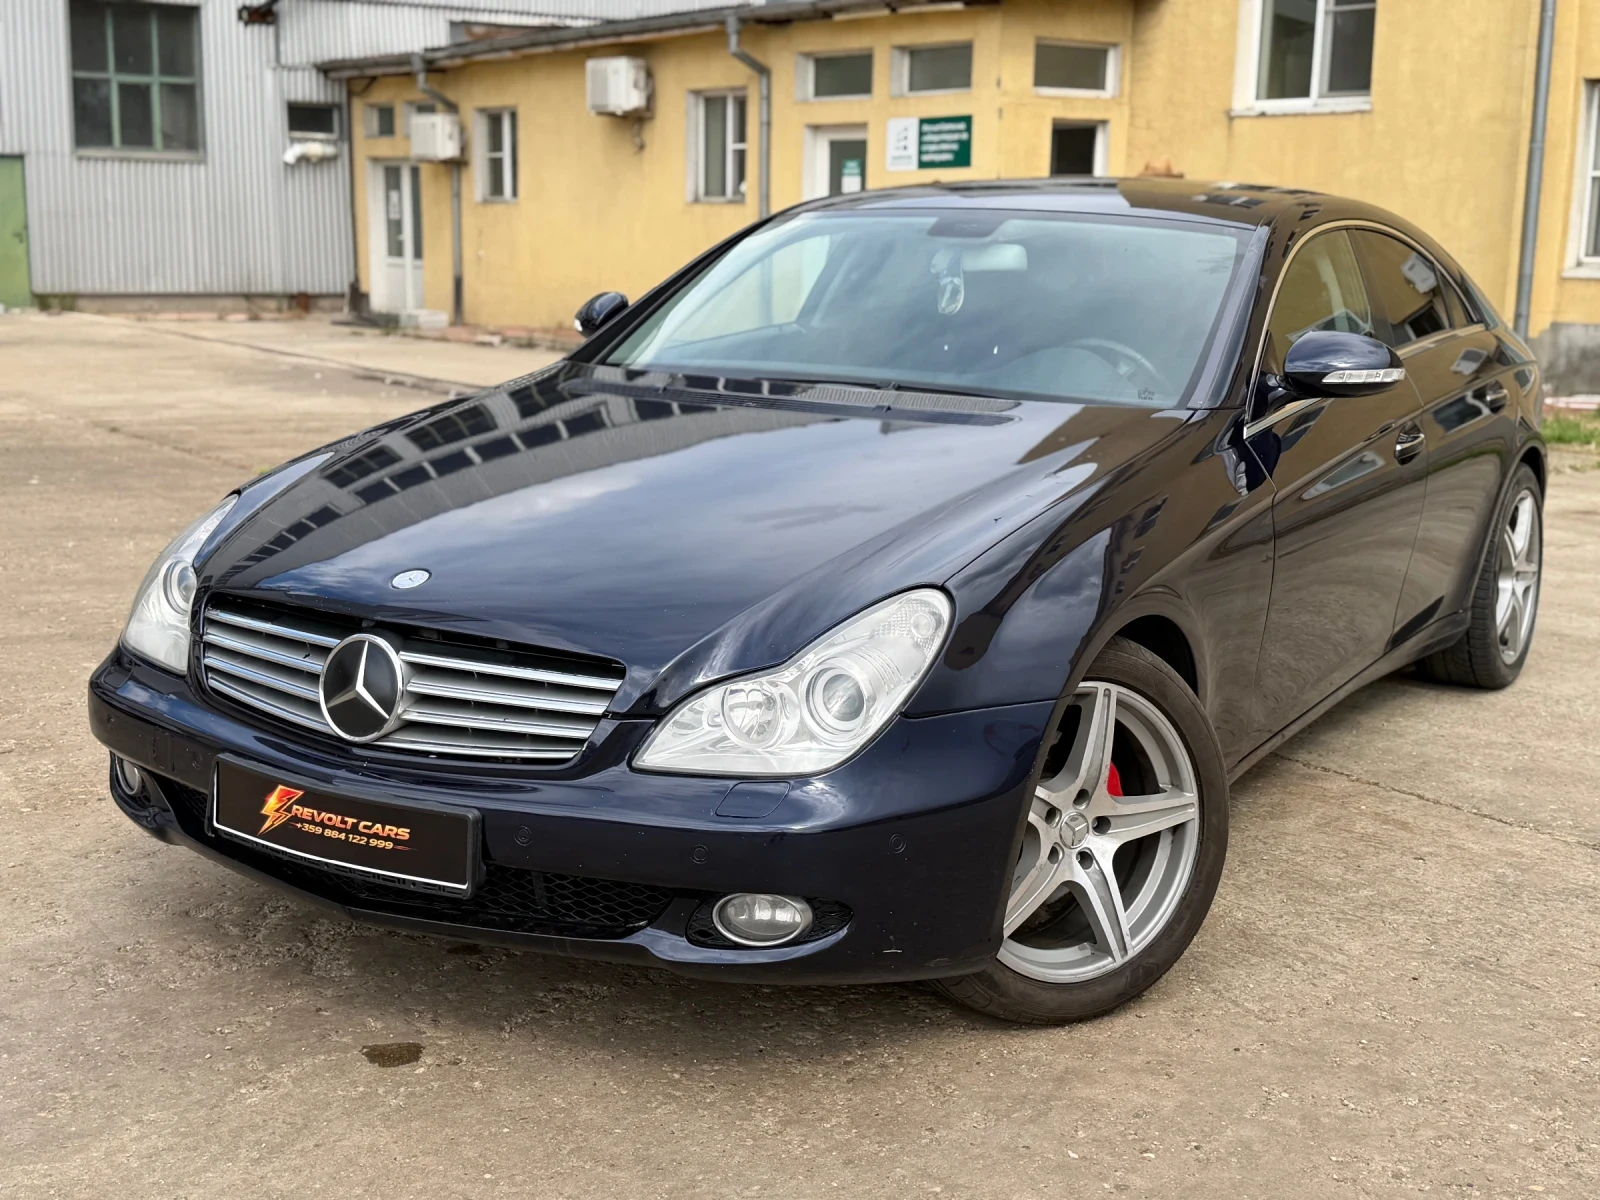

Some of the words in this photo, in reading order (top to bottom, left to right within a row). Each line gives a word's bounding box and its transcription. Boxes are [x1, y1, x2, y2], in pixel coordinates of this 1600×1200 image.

[291, 804, 357, 830] REVOLT
[358, 821, 411, 840] CARS
[323, 828, 346, 840] 884
[347, 834, 367, 845] 122
[369, 838, 394, 850] 999
